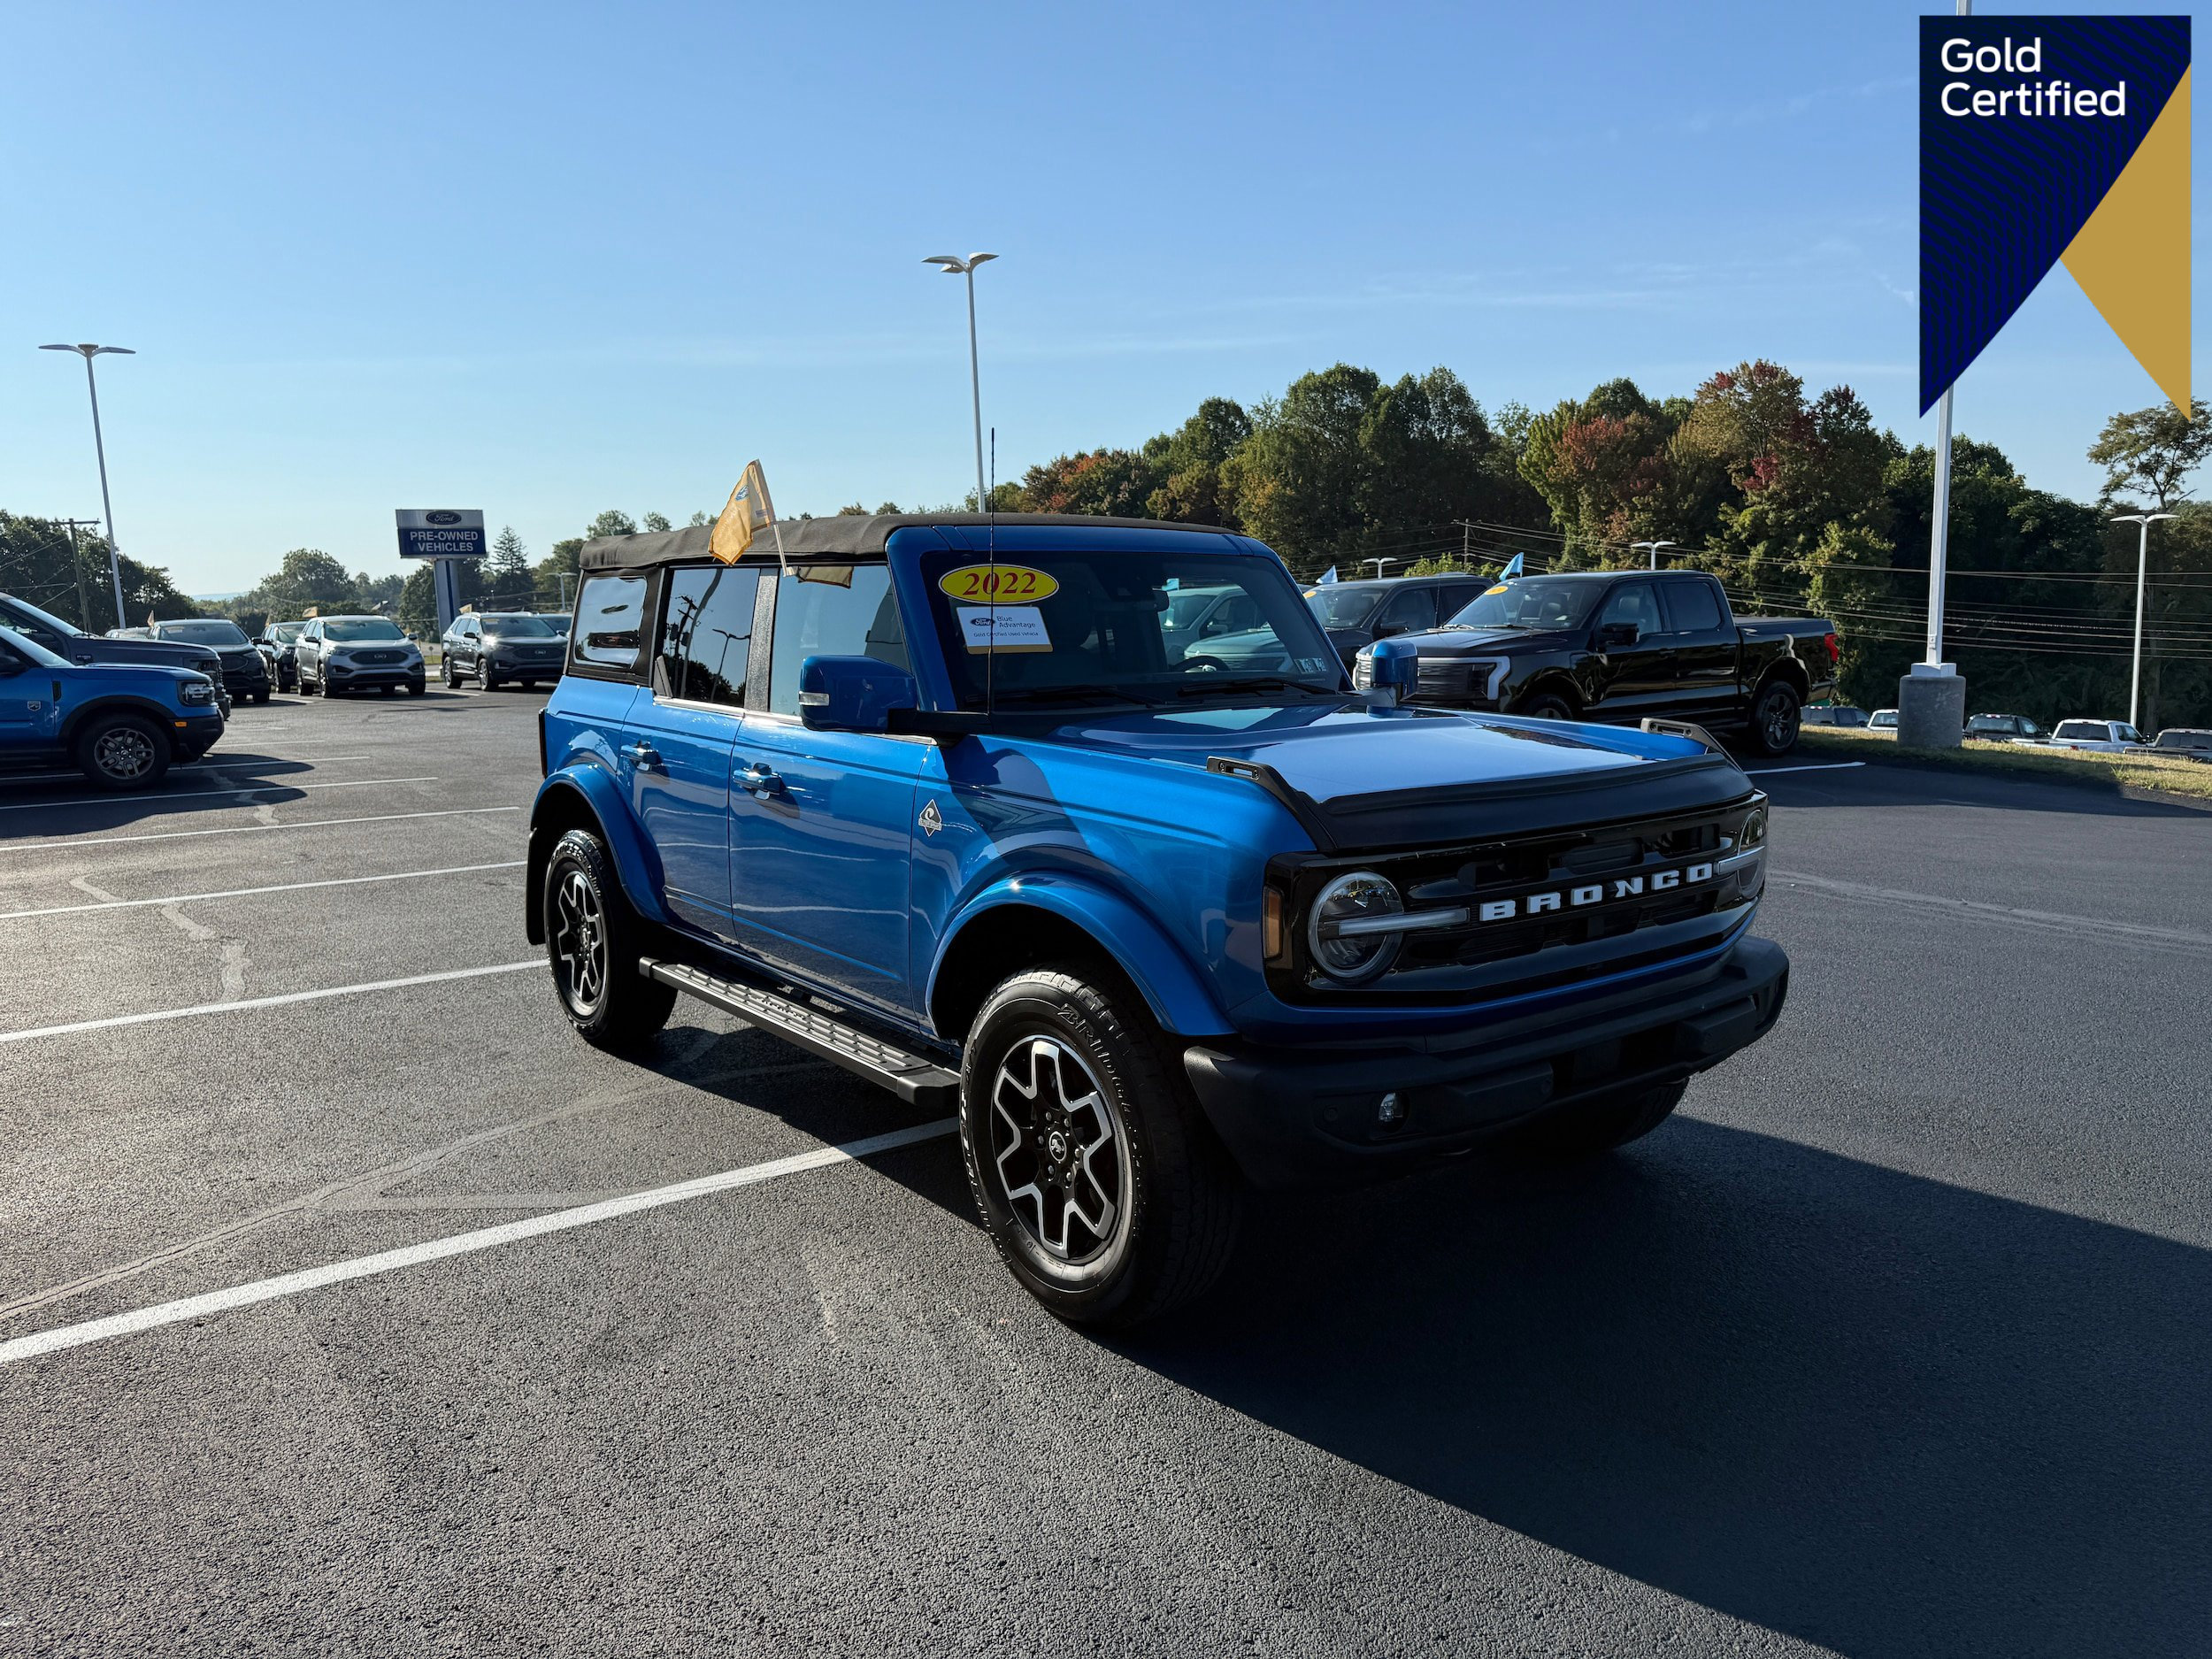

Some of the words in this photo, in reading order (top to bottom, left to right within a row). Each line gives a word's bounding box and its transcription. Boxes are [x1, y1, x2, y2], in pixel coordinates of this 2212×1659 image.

[434, 513, 455, 522] Ford
[410, 531, 479, 541] PRE-OWNED
[418, 541, 474, 552] VEHICLES
[963, 572, 1036, 595] 2022
[1479, 863, 1713, 922] BRONCO
